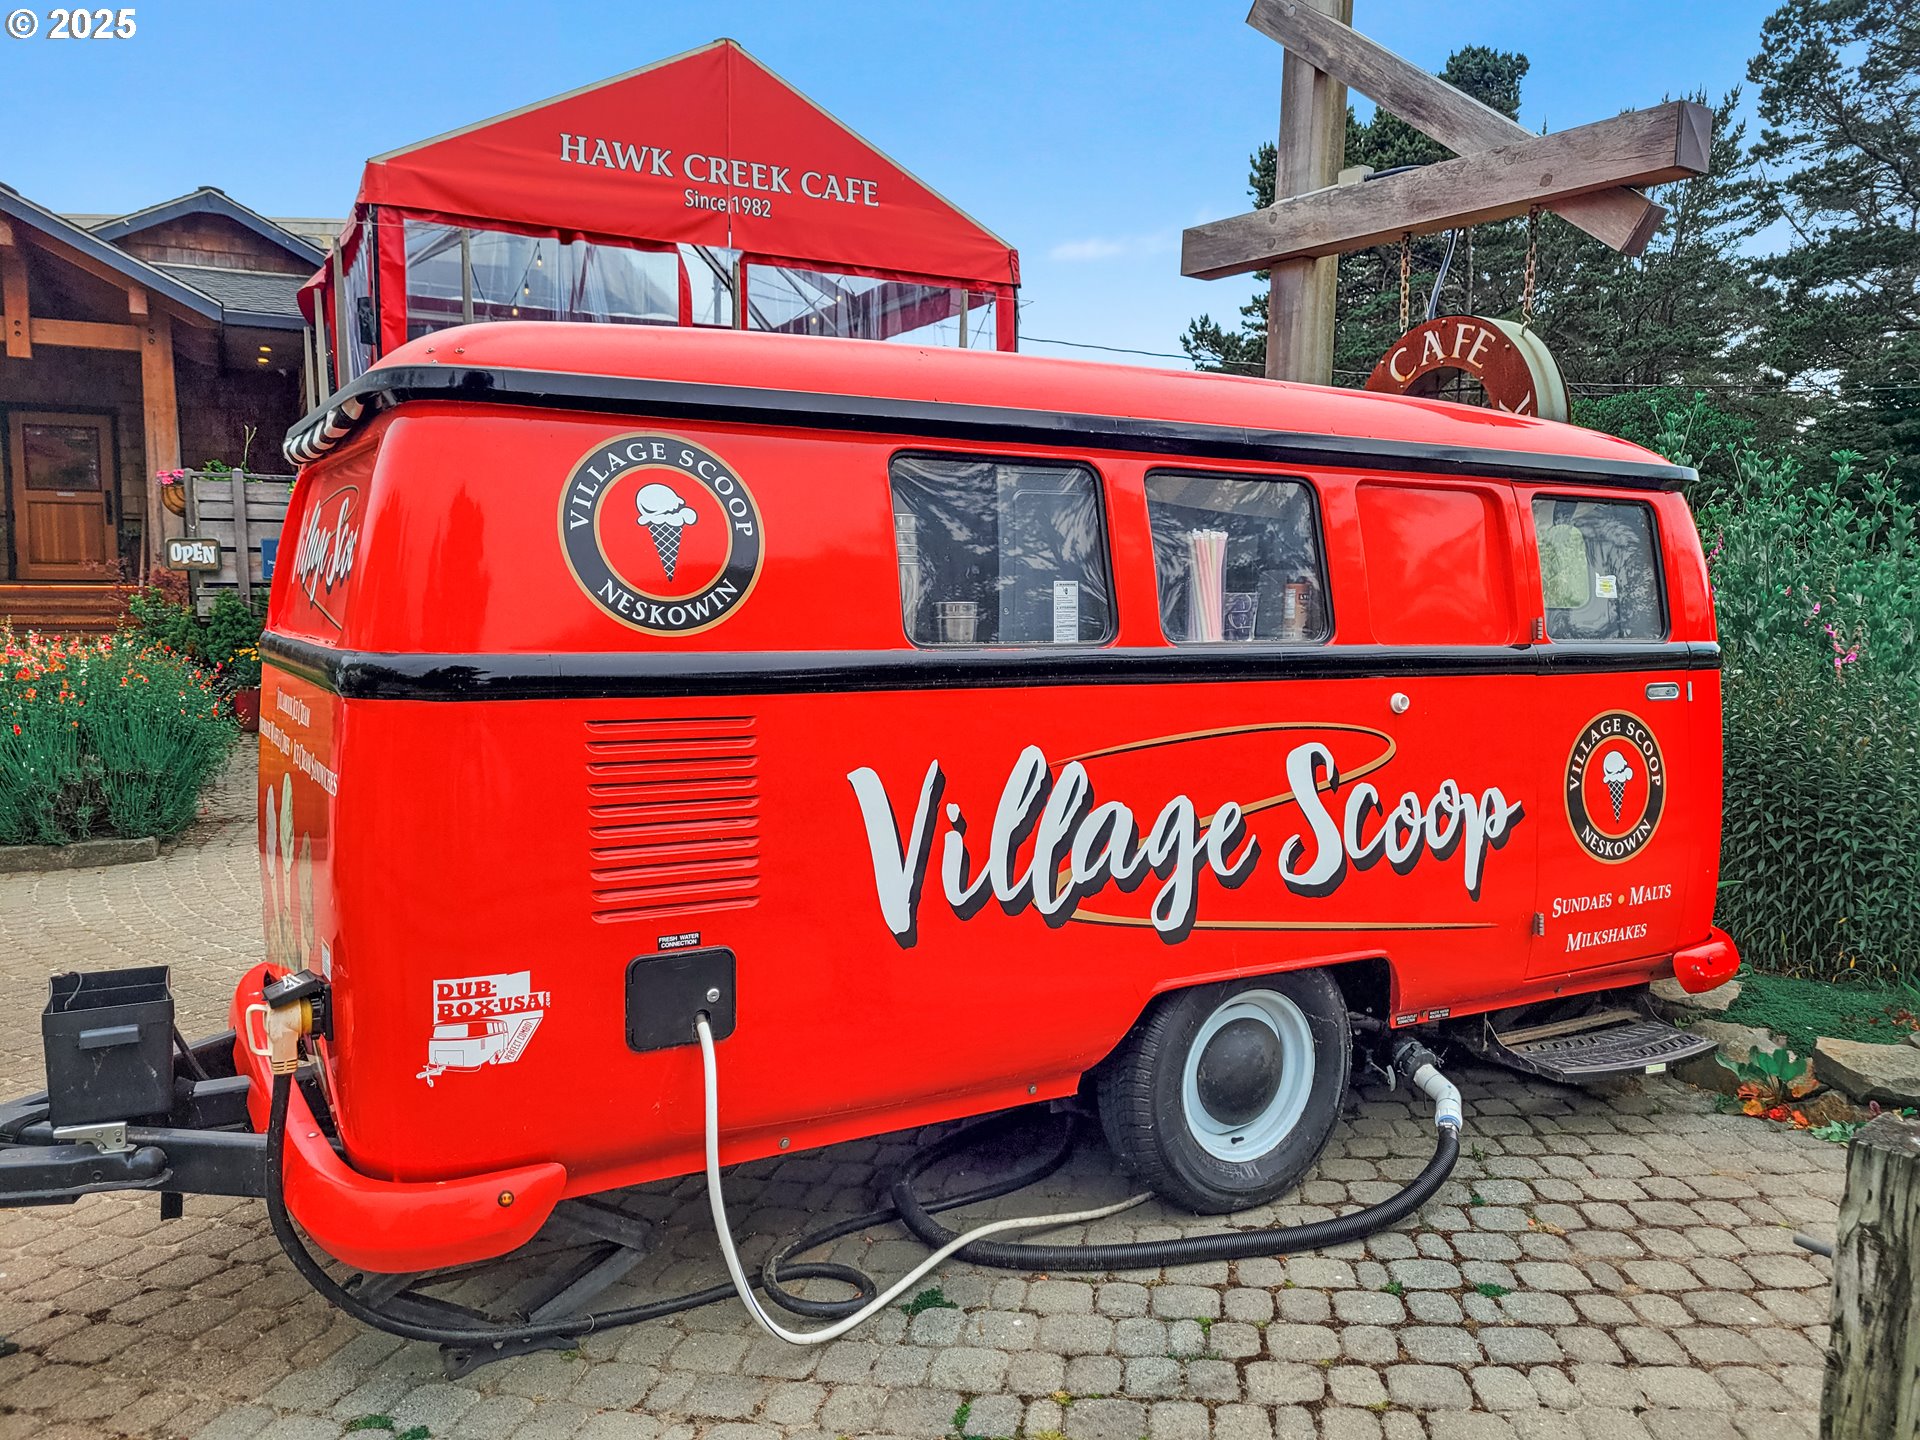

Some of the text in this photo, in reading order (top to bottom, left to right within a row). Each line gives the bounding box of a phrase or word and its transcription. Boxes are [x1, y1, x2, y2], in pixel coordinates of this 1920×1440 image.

[559, 133, 880, 207] HAWK CREEK CAFE
[684, 188, 772, 218] Since 1982
[1390, 323, 1496, 382] CAFE
[569, 442, 753, 537] VILLAGE SCOOP
[170, 542, 217, 565] OPEN
[597, 578, 739, 626] NESKOWIN
[1569, 718, 1661, 792] VILLAGE SCOOP
[847, 741, 1522, 945] Village Scoop
[1581, 818, 1651, 857] NESKOWIN
[1552, 883, 1672, 919] SUNDAES MALTS
[658, 932, 699, 944] FRESH WATER
[660, 939, 698, 949] CONNECTION
[1565, 923, 1648, 953] MILKSHAKES
